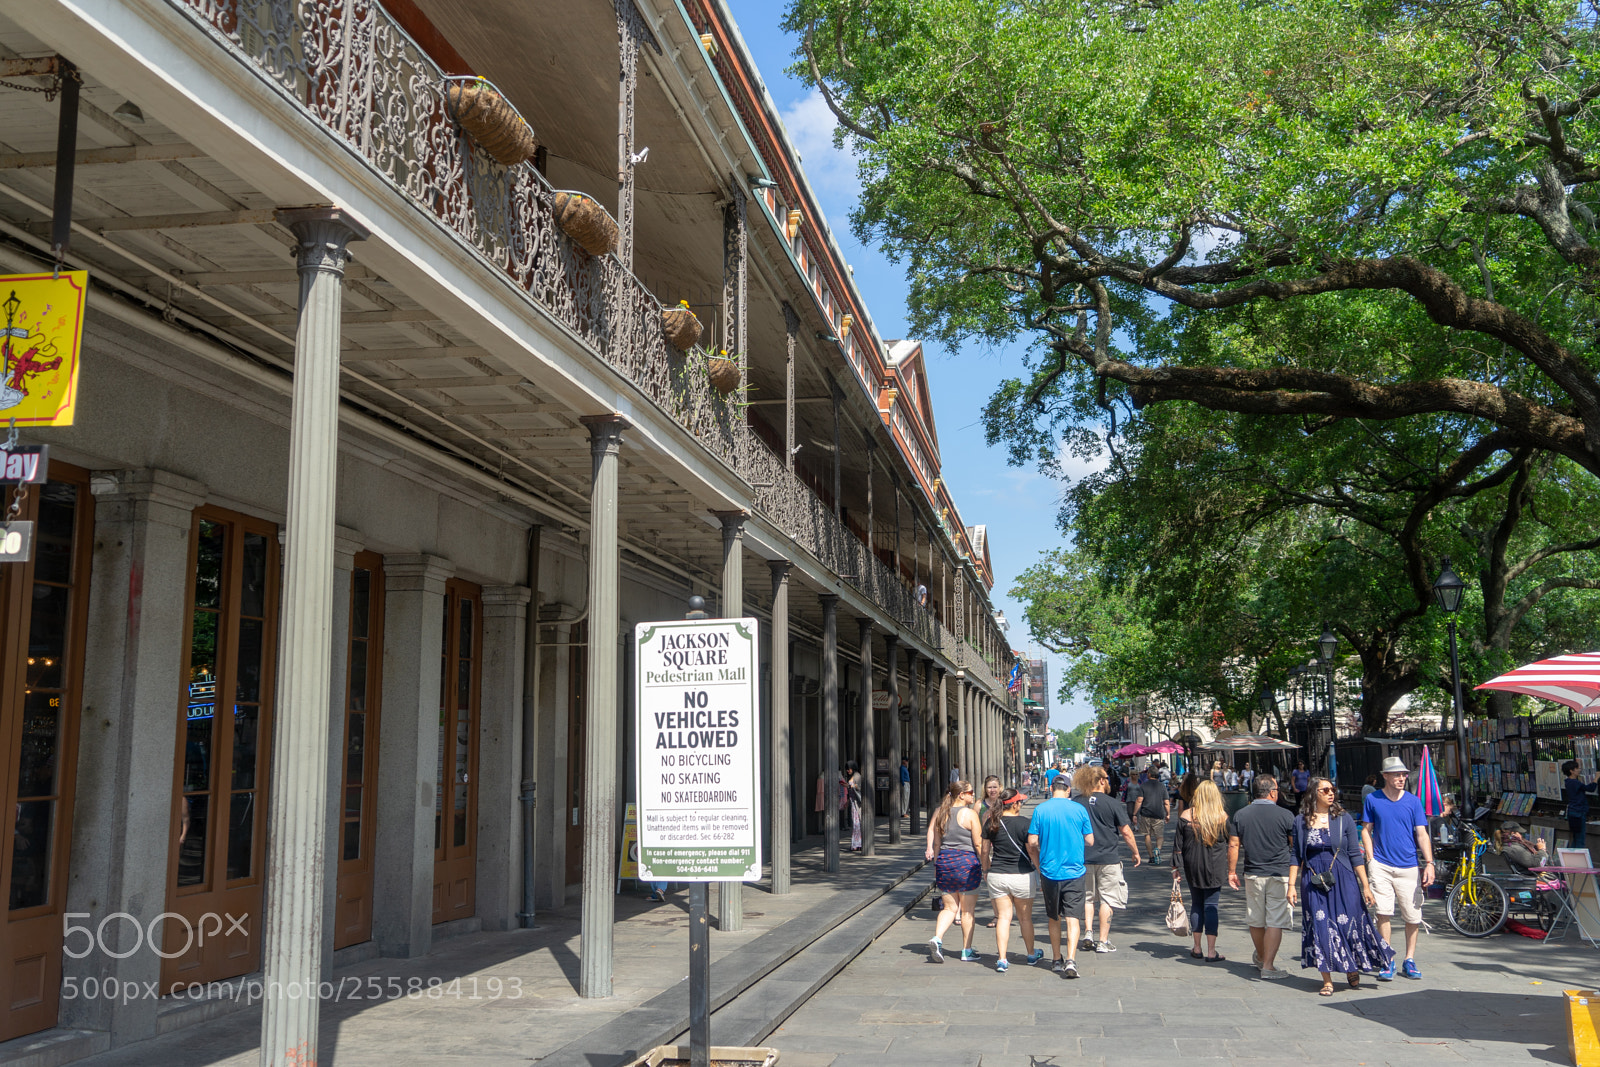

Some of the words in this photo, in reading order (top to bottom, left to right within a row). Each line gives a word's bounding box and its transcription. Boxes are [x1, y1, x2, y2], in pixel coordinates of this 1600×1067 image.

[658, 632, 730, 654] JACKSON
[663, 650, 728, 671] SQUARE
[646, 669, 713, 683] Pedestrian
[718, 667, 746, 681] Mall
[684, 691, 709, 708] NO
[654, 710, 739, 729] VEHICLES
[655, 730, 738, 749] ALLOWED
[661, 754, 675, 767] NO
[678, 753, 731, 766] BICYCLING
[661, 773, 675, 785] NO
[678, 772, 721, 784] SKATING
[661, 791, 672, 803] NO
[674, 790, 737, 803] SKATEBOARDING
[646, 814, 659, 822] Mall
[660, 814, 665, 822] is
[666, 814, 687, 823] subject
[690, 814, 696, 822] to
[697, 814, 719, 822] regular
[721, 814, 748, 823] cleaning.
[700, 823, 711, 831] will
[722, 823, 749, 831] removed
[700, 832, 711, 840] Sec
[713, 832, 735, 840] 66-282
[673, 850, 707, 858] emergency,
[707, 849, 728, 857] please
[728, 848, 740, 856] dial
[741, 848, 751, 856] 911
[652, 857, 695, 866] Non-emergency
